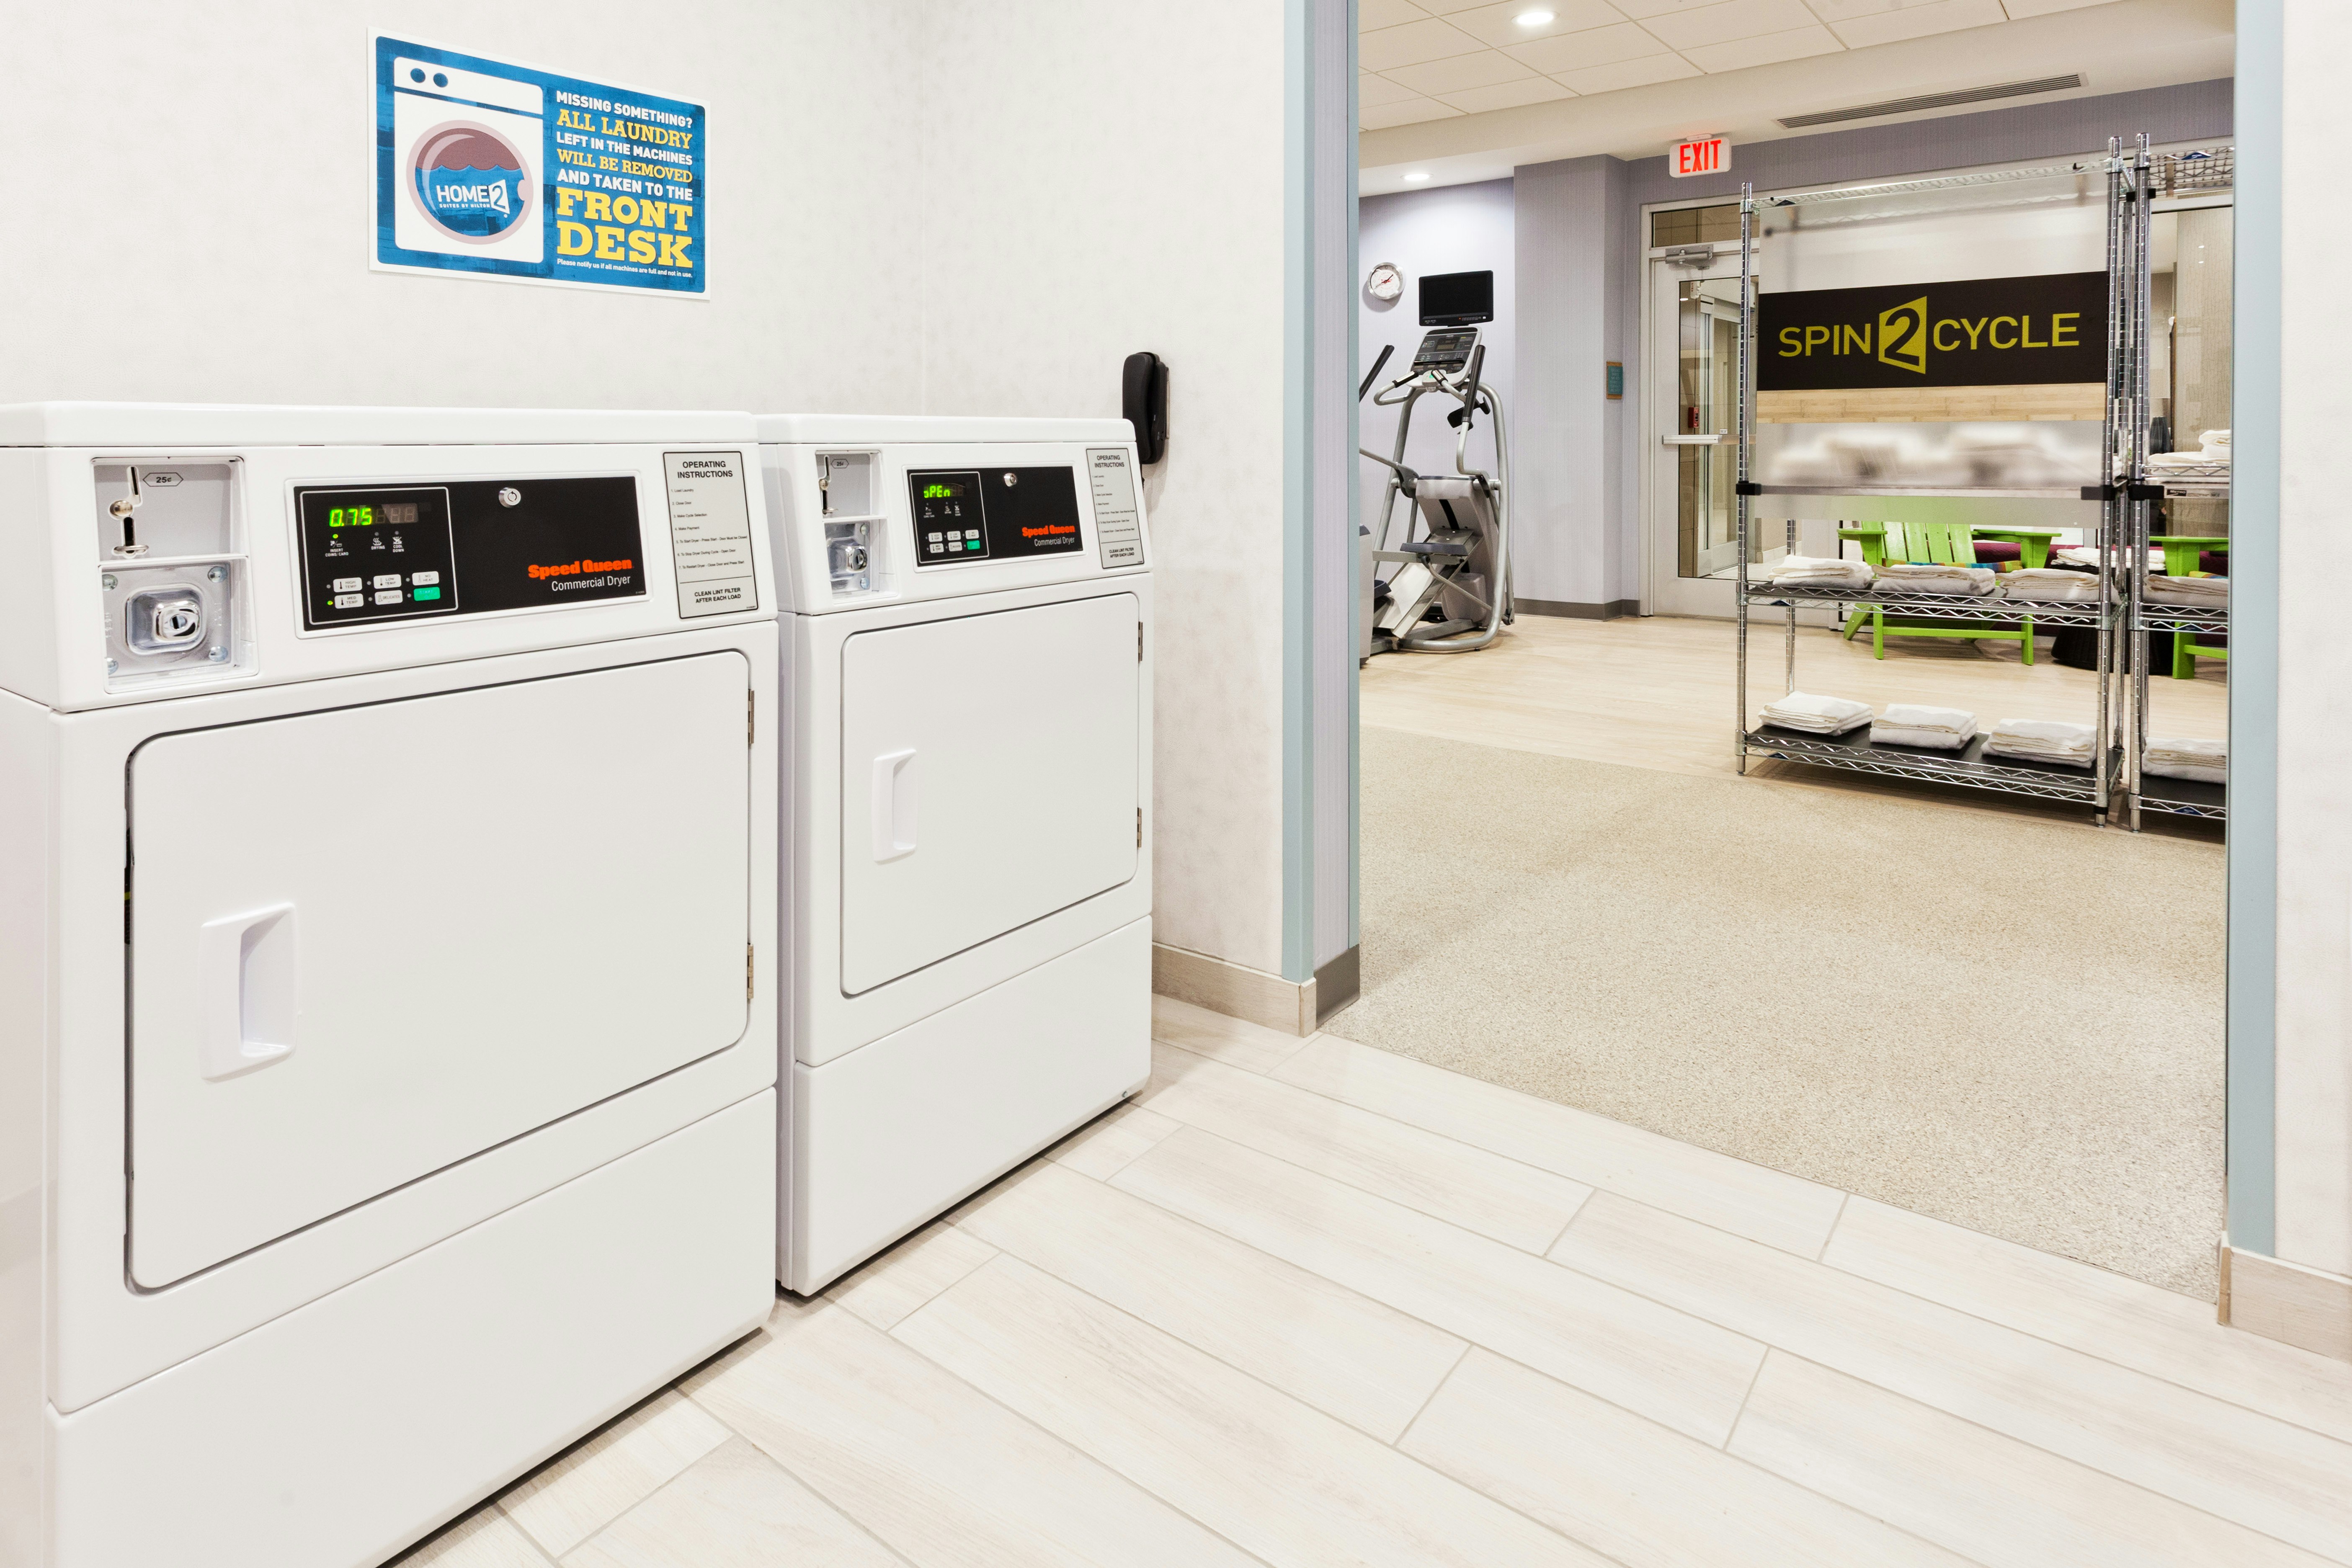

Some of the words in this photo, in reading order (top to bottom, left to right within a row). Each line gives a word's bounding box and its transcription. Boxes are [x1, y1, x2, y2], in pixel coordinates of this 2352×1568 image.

[557, 90, 611, 112] MISSING
[614, 103, 693, 129] SOMETHING?
[557, 108, 596, 132] ALL
[601, 117, 692, 149] LAUNDRY
[557, 132, 588, 147] LEFT
[591, 137, 604, 150] IN
[606, 140, 630, 155] THE
[633, 145, 693, 165] MACHINES
[1680, 139, 1722, 173] EXIT
[557, 149, 596, 168] WILL
[599, 156, 618, 171] BE
[622, 160, 693, 183] REMOVED
[557, 169, 590, 185] AND
[593, 173, 642, 193] TAKEN
[645, 182, 663, 196] TO
[666, 186, 693, 201] THE
[557, 187, 693, 231] FRONT
[557, 220, 693, 268] DESK
[1778, 323, 1871, 357] SPIN
[1884, 307, 1920, 367] 2
[1933, 312, 2080, 351] CYCLE
[329, 508, 372, 527] 0.75
[1022, 525, 1049, 538] Speed
[1049, 525, 1075, 534] Queen
[1034, 538, 1061, 546] Commercial
[528, 561, 580, 580] Speed
[582, 559, 632, 573] Queen
[552, 577, 604, 591] Commercial
[607, 576, 631, 587] Dryer
